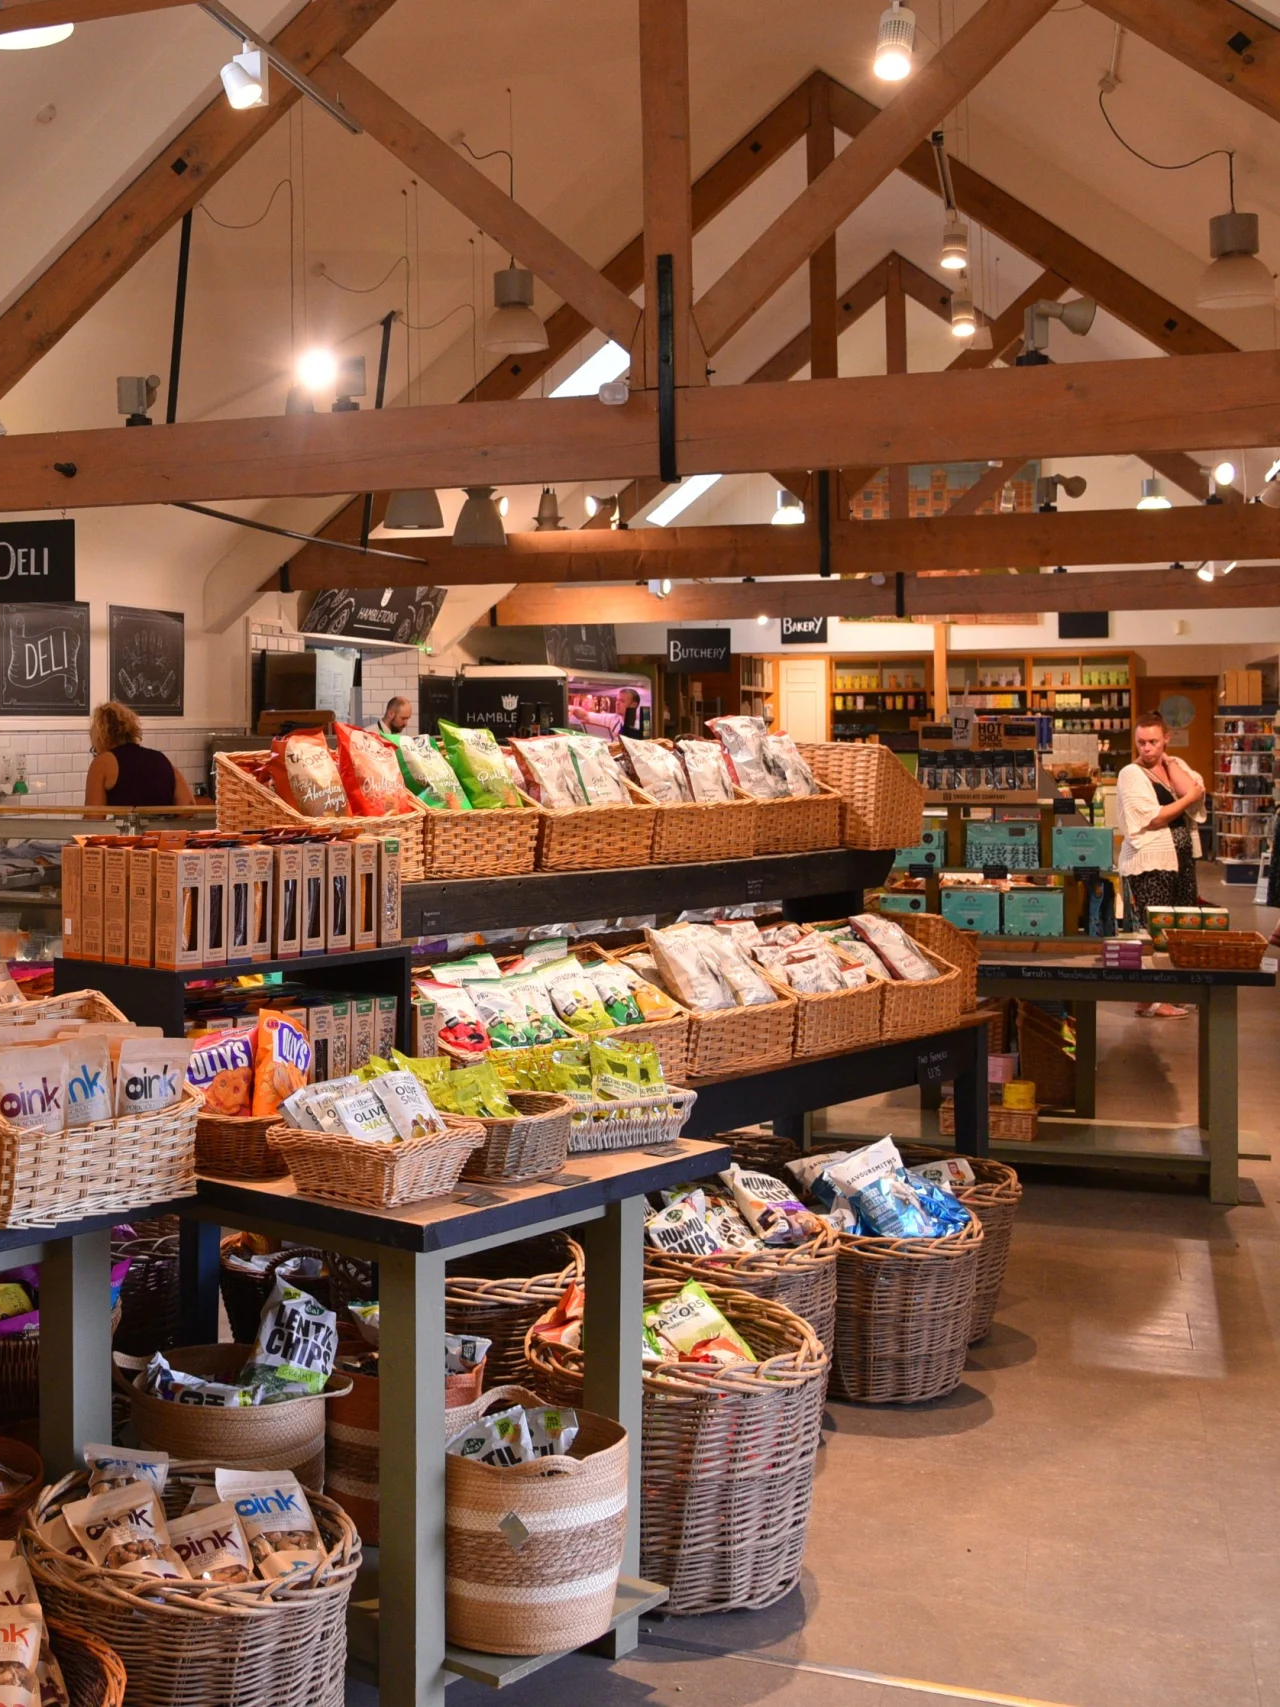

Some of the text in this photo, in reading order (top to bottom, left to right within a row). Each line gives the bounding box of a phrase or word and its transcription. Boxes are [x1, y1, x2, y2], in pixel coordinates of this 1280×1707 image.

[782, 616, 824, 635] BAKERY
[25, 632, 69, 680] DELI
[670, 640, 727, 662] BUTCHERY
[978, 723, 1002, 734] HOT
[190, 1041, 249, 1080] OLLY'S
[282, 1027, 308, 1071] OLLY'S
[0, 1076, 61, 1118] oink
[125, 1064, 177, 1101] oink
[741, 1177, 785, 1191] HUMMU
[846, 1156, 898, 1186] SAVOURSMITHS
[657, 1217, 704, 1248] HUMMU
[265, 1328, 331, 1376] CHIPS
[235, 1489, 303, 1517] oink
